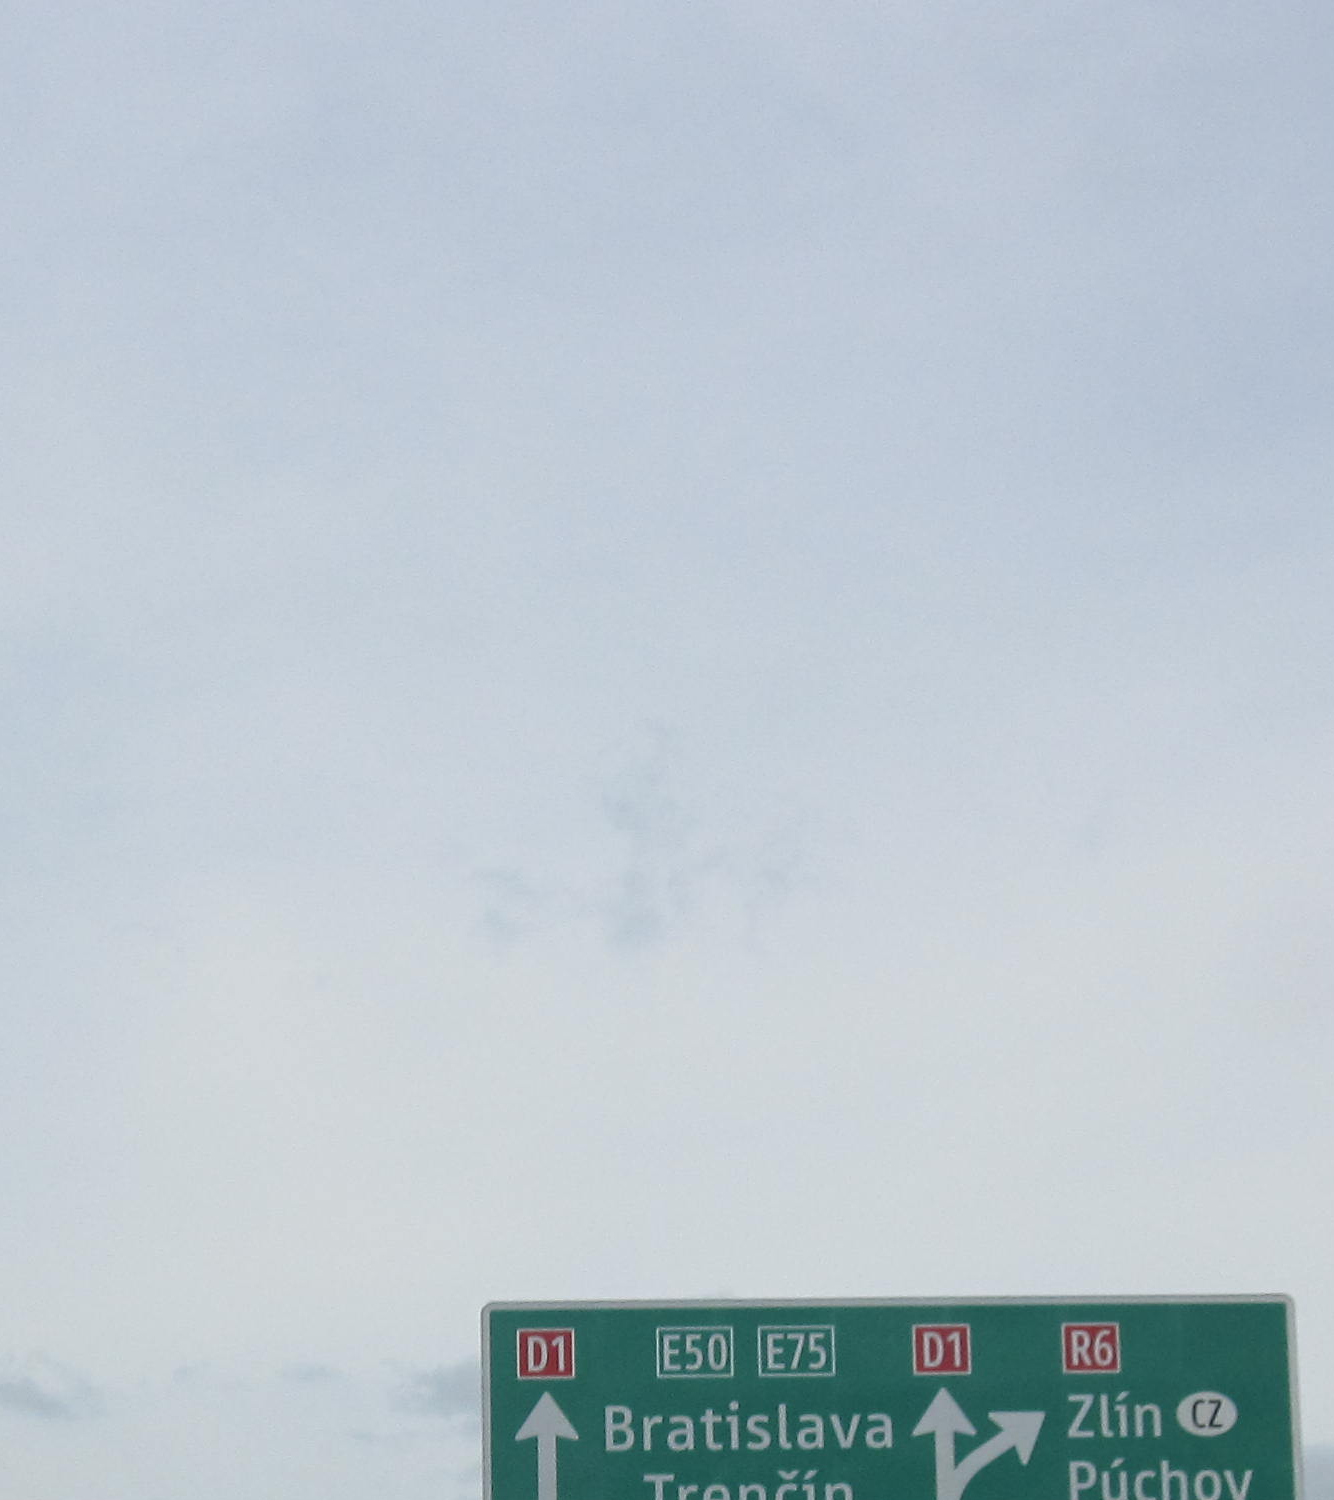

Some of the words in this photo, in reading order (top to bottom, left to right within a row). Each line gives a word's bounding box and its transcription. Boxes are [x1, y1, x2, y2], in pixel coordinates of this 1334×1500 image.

[527, 1335, 565, 1373] D1
[662, 1333, 728, 1371] E50
[766, 1332, 827, 1371] E75
[922, 1331, 961, 1368] D1
[1070, 1329, 1114, 1367] R6
[604, 1400, 894, 1452] Bratislava
[1067, 1391, 1162, 1439] Zlín
[1190, 1399, 1224, 1429] CZ
